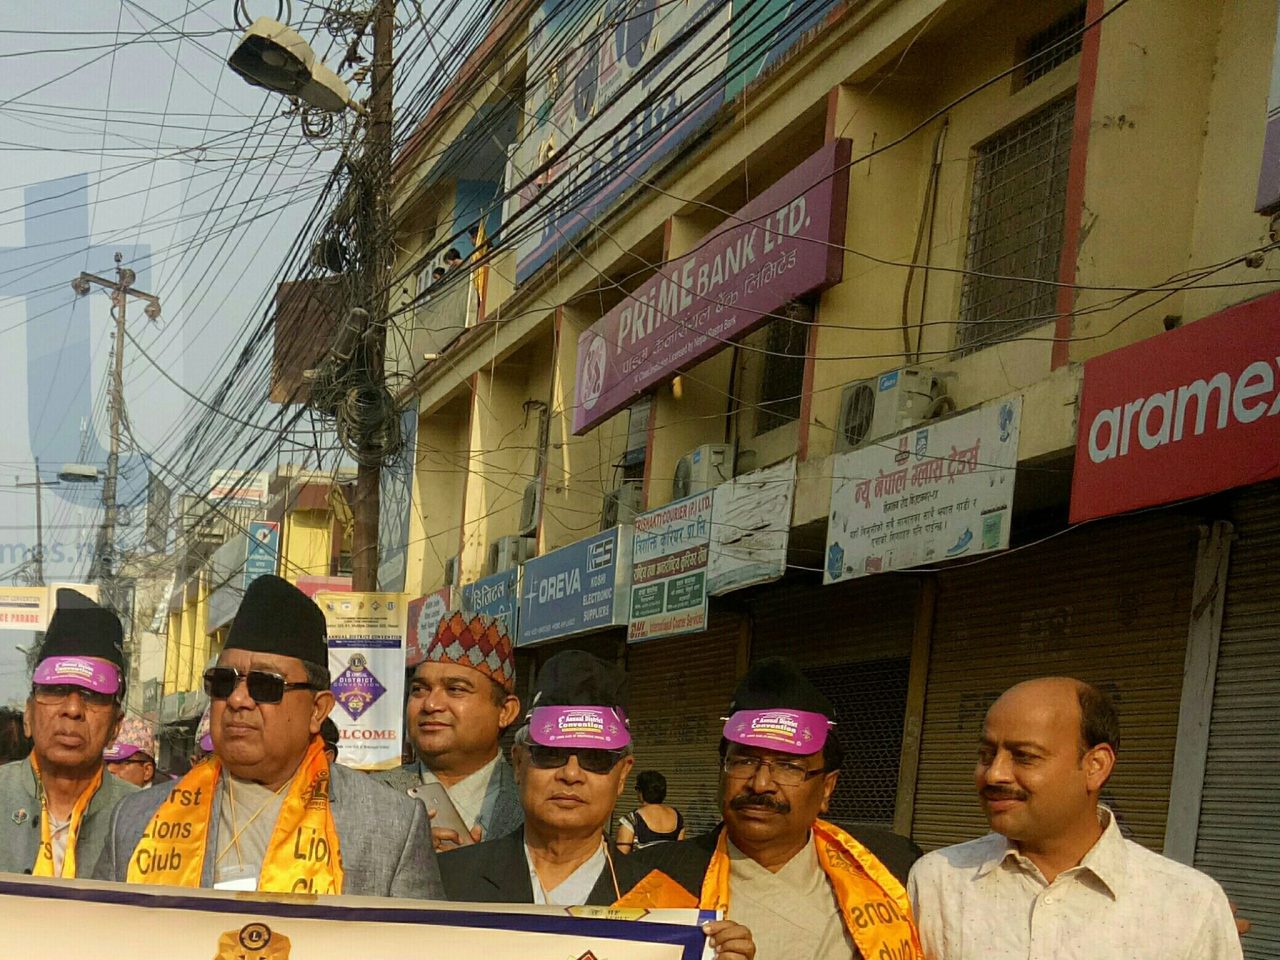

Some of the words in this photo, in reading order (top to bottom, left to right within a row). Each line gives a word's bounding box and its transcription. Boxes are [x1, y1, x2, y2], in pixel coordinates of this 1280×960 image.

[697, 227, 759, 300] BANK
[763, 196, 811, 254] LTD.
[874, 467, 909, 498] नेपाल
[538, 567, 581, 604] OREVA
[582, 587, 613, 606] ELECTRONIC
[11, 613, 39, 623] PARADE
[583, 604, 609, 622] SUPPLIERS
[339, 729, 397, 740] LCOME
[558, 722, 604, 730] Convention
[751, 723, 797, 734] Convention
[171, 786, 202, 807] rst
[136, 846, 182, 875] Club
